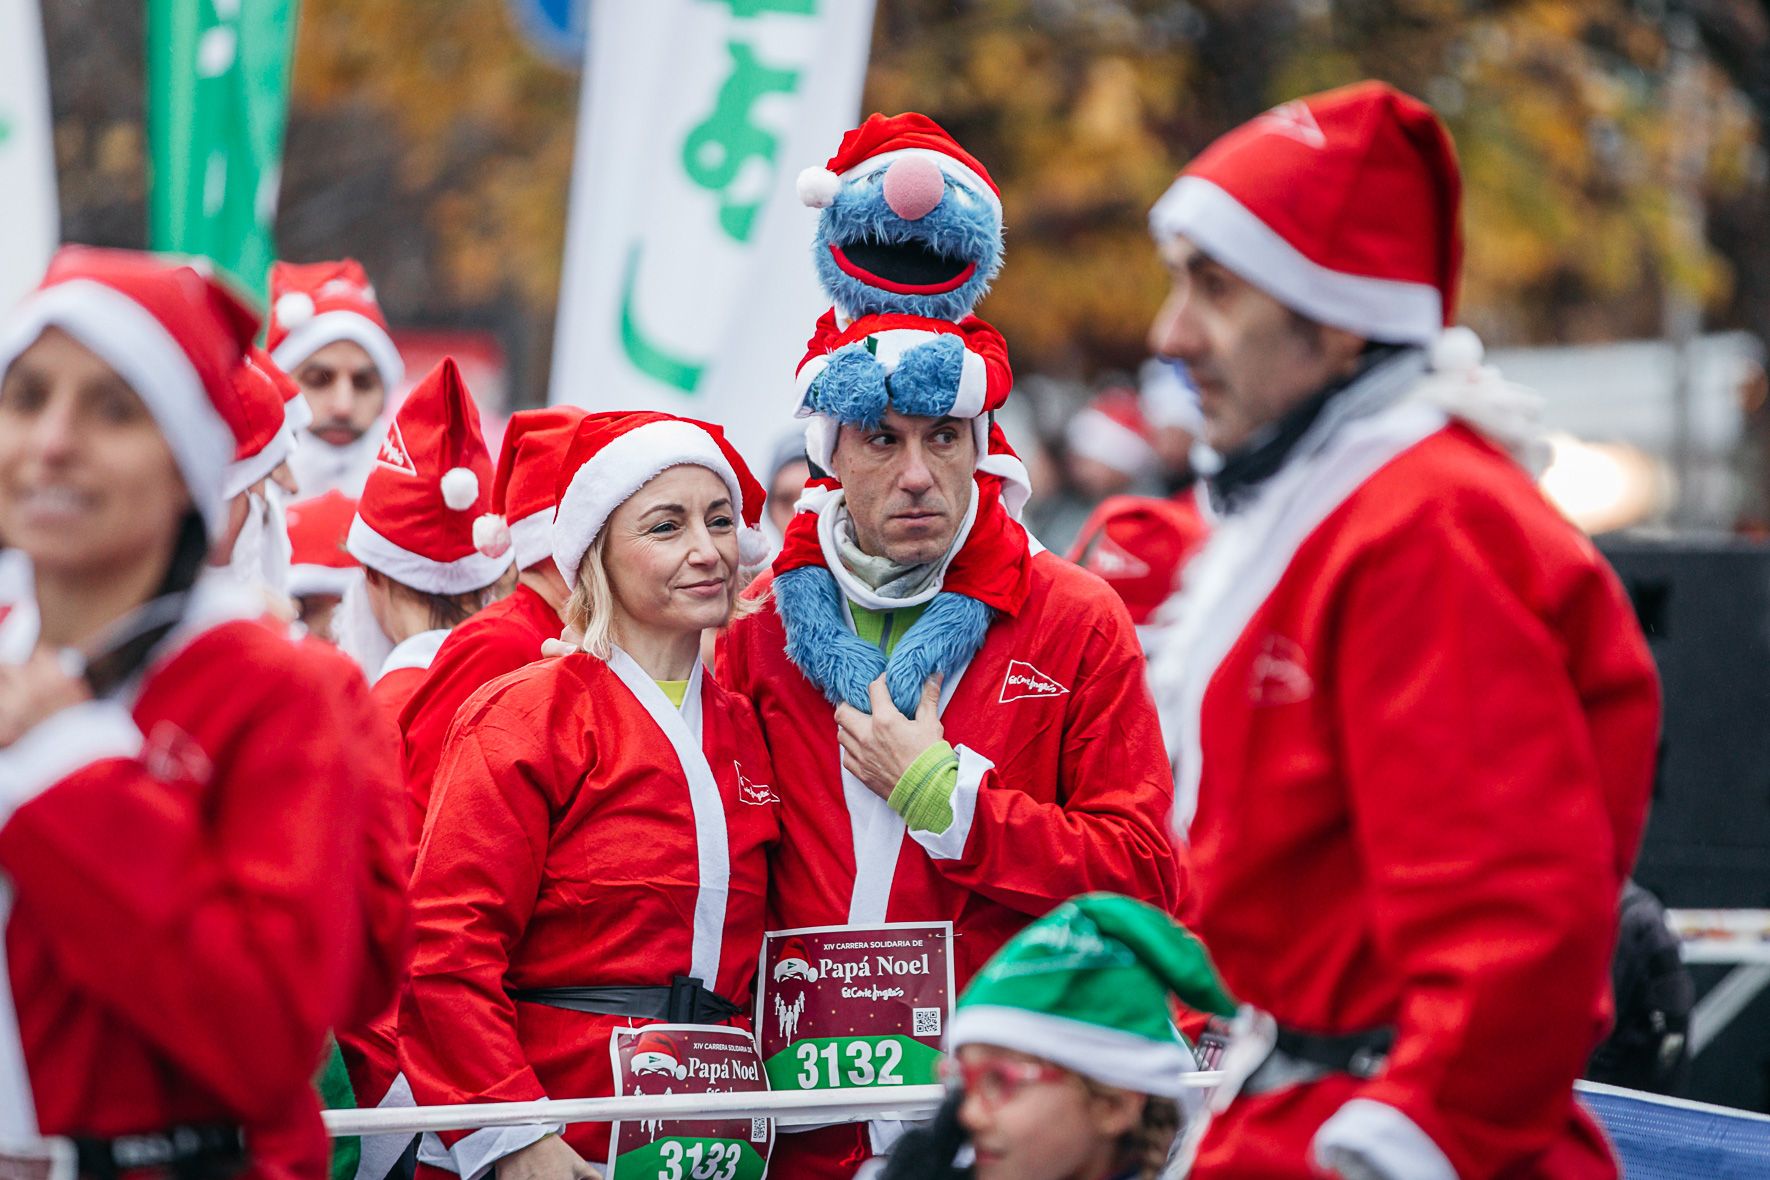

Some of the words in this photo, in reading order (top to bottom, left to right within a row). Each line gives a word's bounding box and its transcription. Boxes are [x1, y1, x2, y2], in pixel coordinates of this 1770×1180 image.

[836, 942, 869, 950] CARRERA
[870, 940, 911, 949] SOLIDARIA
[819, 956, 872, 984] Papá
[876, 953, 930, 976] Noel
[693, 1042, 704, 1050] XIV
[704, 1043, 728, 1051] CARRERA
[687, 1057, 730, 1084] Papá
[731, 1059, 760, 1081] Noel
[797, 1039, 904, 1089] 3132
[658, 1140, 741, 1180] 3133
